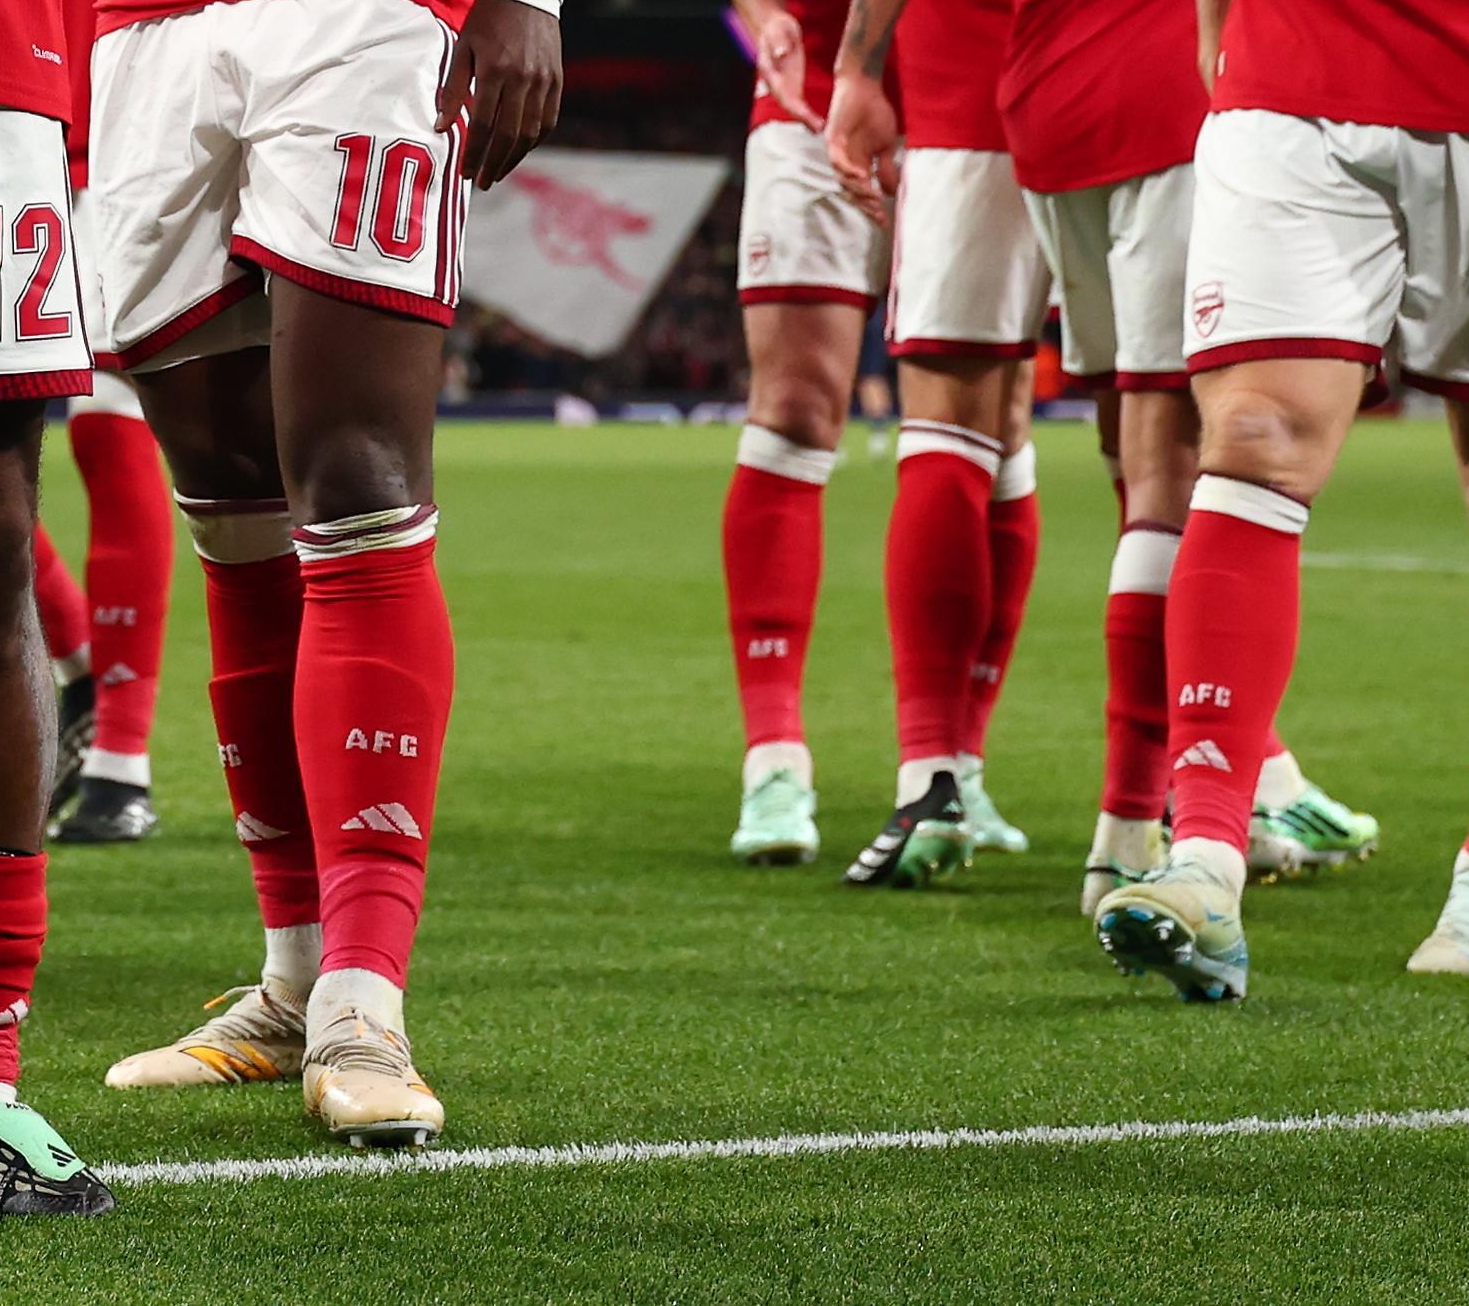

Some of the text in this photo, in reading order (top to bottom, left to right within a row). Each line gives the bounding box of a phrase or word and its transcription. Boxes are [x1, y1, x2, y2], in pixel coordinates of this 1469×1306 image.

[329, 133, 437, 263] 10
[1179, 683, 1231, 708] AFC
[346, 727, 418, 757] AFC
